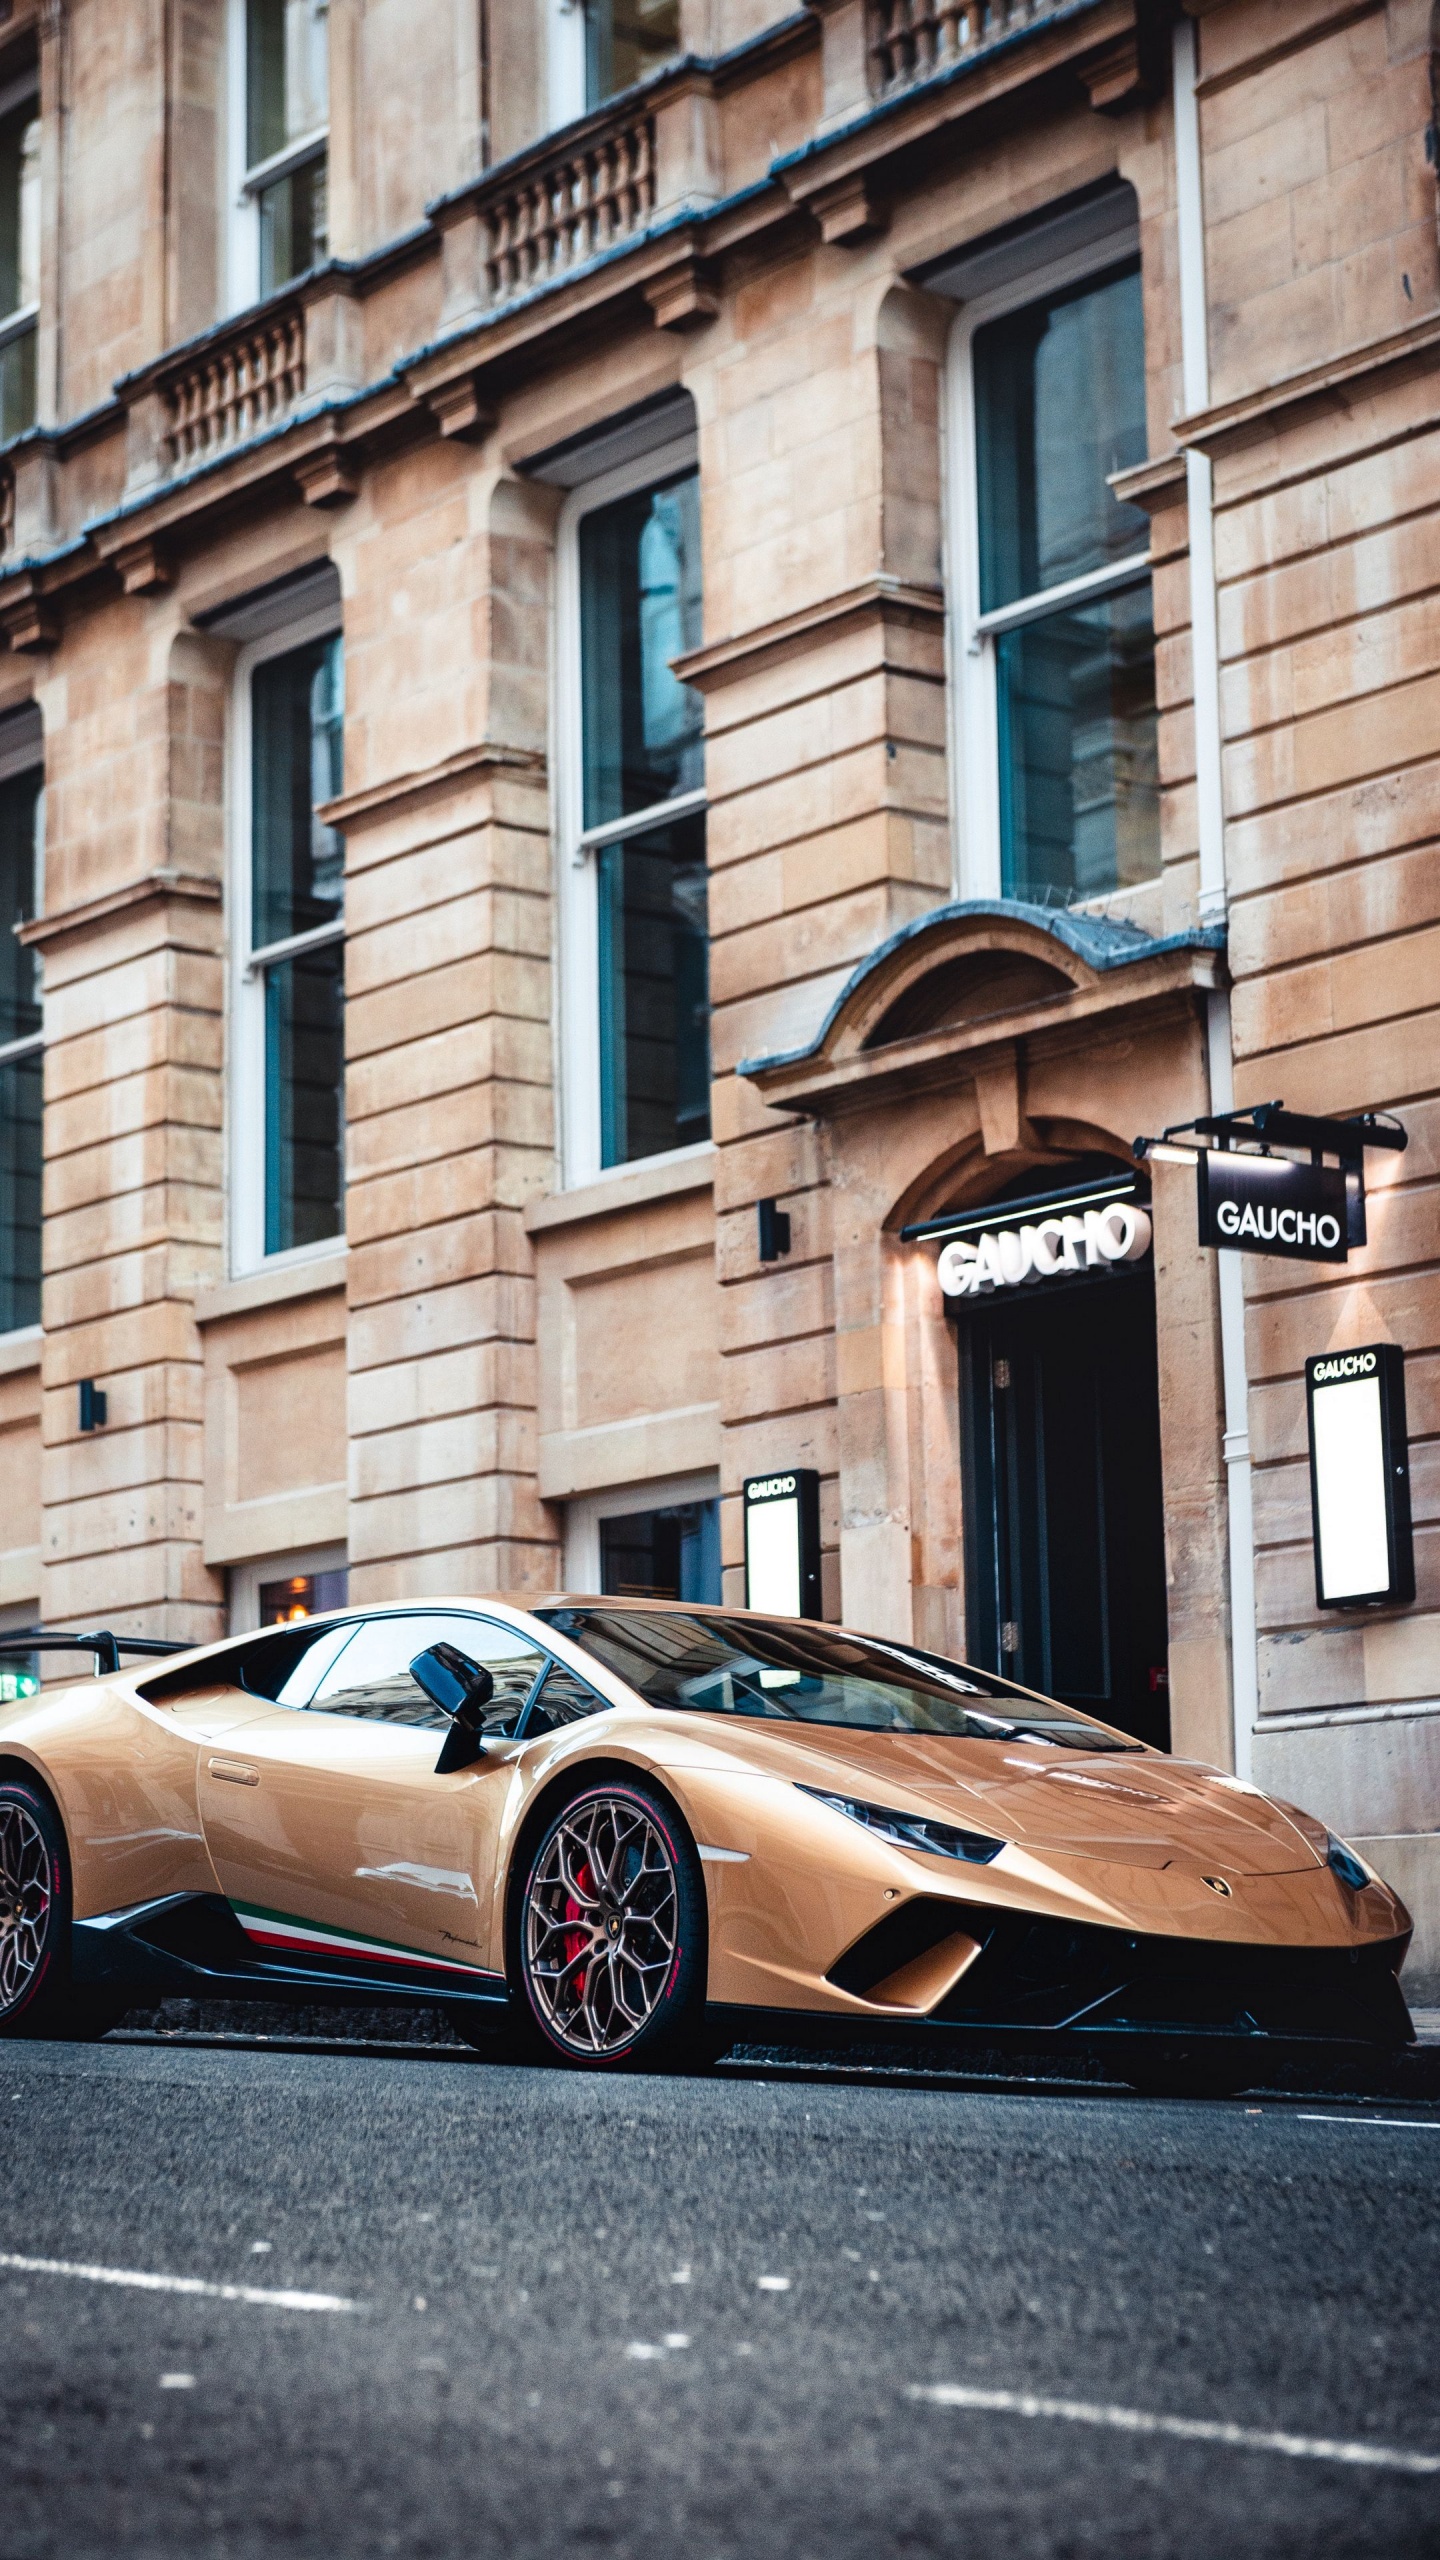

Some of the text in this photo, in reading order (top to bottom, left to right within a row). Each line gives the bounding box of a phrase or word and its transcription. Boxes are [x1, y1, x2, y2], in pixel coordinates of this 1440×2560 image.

[1217, 1200, 1340, 1248] GAUCHO
[937, 1202, 1152, 1297] GAUCHO
[1313, 1352, 1377, 1381] GAUCHO
[747, 1476, 796, 1499] GAUCHO
